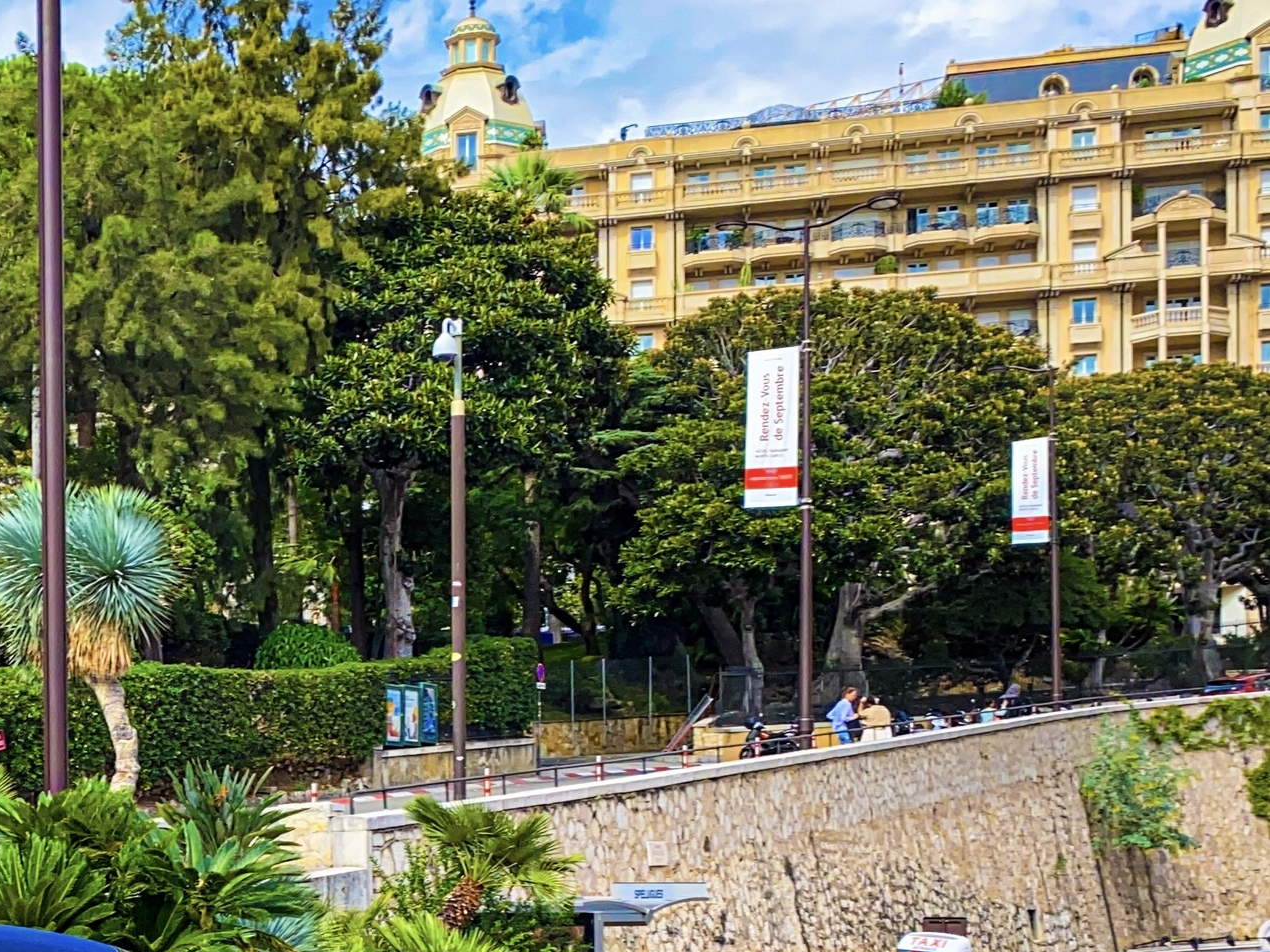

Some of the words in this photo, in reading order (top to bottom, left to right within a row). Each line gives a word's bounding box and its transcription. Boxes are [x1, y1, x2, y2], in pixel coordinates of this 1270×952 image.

[759, 372, 770, 442] Rendez-Vous
[773, 365, 786, 425] Septembre
[773, 427, 784, 441] de
[910, 937, 949, 949] TAXI
